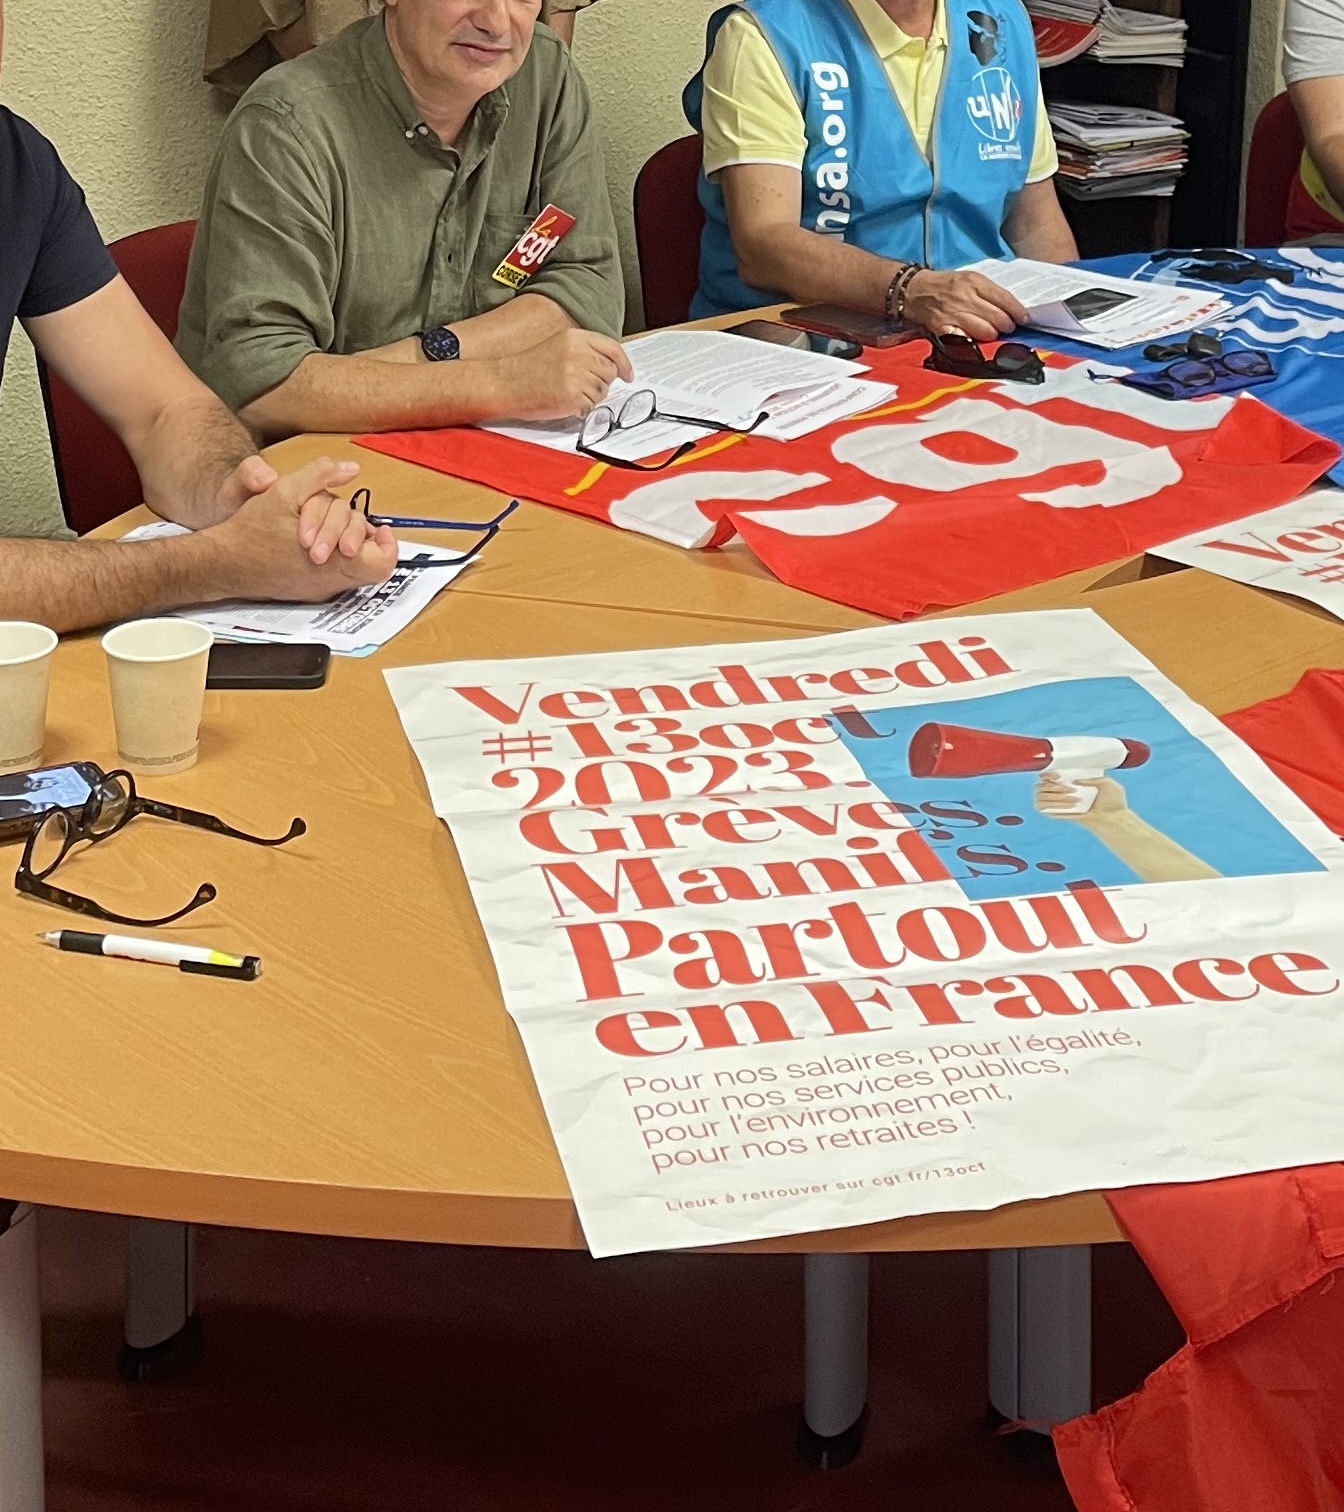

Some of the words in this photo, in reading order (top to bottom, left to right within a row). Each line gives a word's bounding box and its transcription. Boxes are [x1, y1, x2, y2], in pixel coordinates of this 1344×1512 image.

[810, 61, 851, 242] nsa.org
[516, 232, 560, 267] cgt
[446, 636, 1023, 725] Vendredi
[482, 704, 896, 765] #13oct
[491, 748, 873, 812] 2023.
[517, 794, 1025, 855] Grèves.
[531, 829, 1067, 919] Manifs.
[554, 879, 1150, 1003] Partout
[594, 988, 807, 1058] en
[623, 1073, 704, 1096] Pour
[713, 1066, 778, 1087] nos
[786, 1050, 924, 1079] salaires,
[927, 1039, 1002, 1065] pour
[1008, 1027, 1143, 1055] l'égalité,
[633, 1097, 711, 1126] pour
[721, 1090, 786, 1112] nos
[794, 1070, 934, 1103] services
[941, 1057, 1070, 1087] publics,
[642, 1120, 720, 1150] pour
[729, 1082, 1014, 1136] l'environnement,
[651, 1144, 731, 1175] pour
[742, 1138, 808, 1160] nos
[816, 1116, 958, 1151] retraites
[665, 1196, 718, 1212] Lieux
[742, 1181, 829, 1203] retrouver
[835, 1178, 865, 1191] sur
